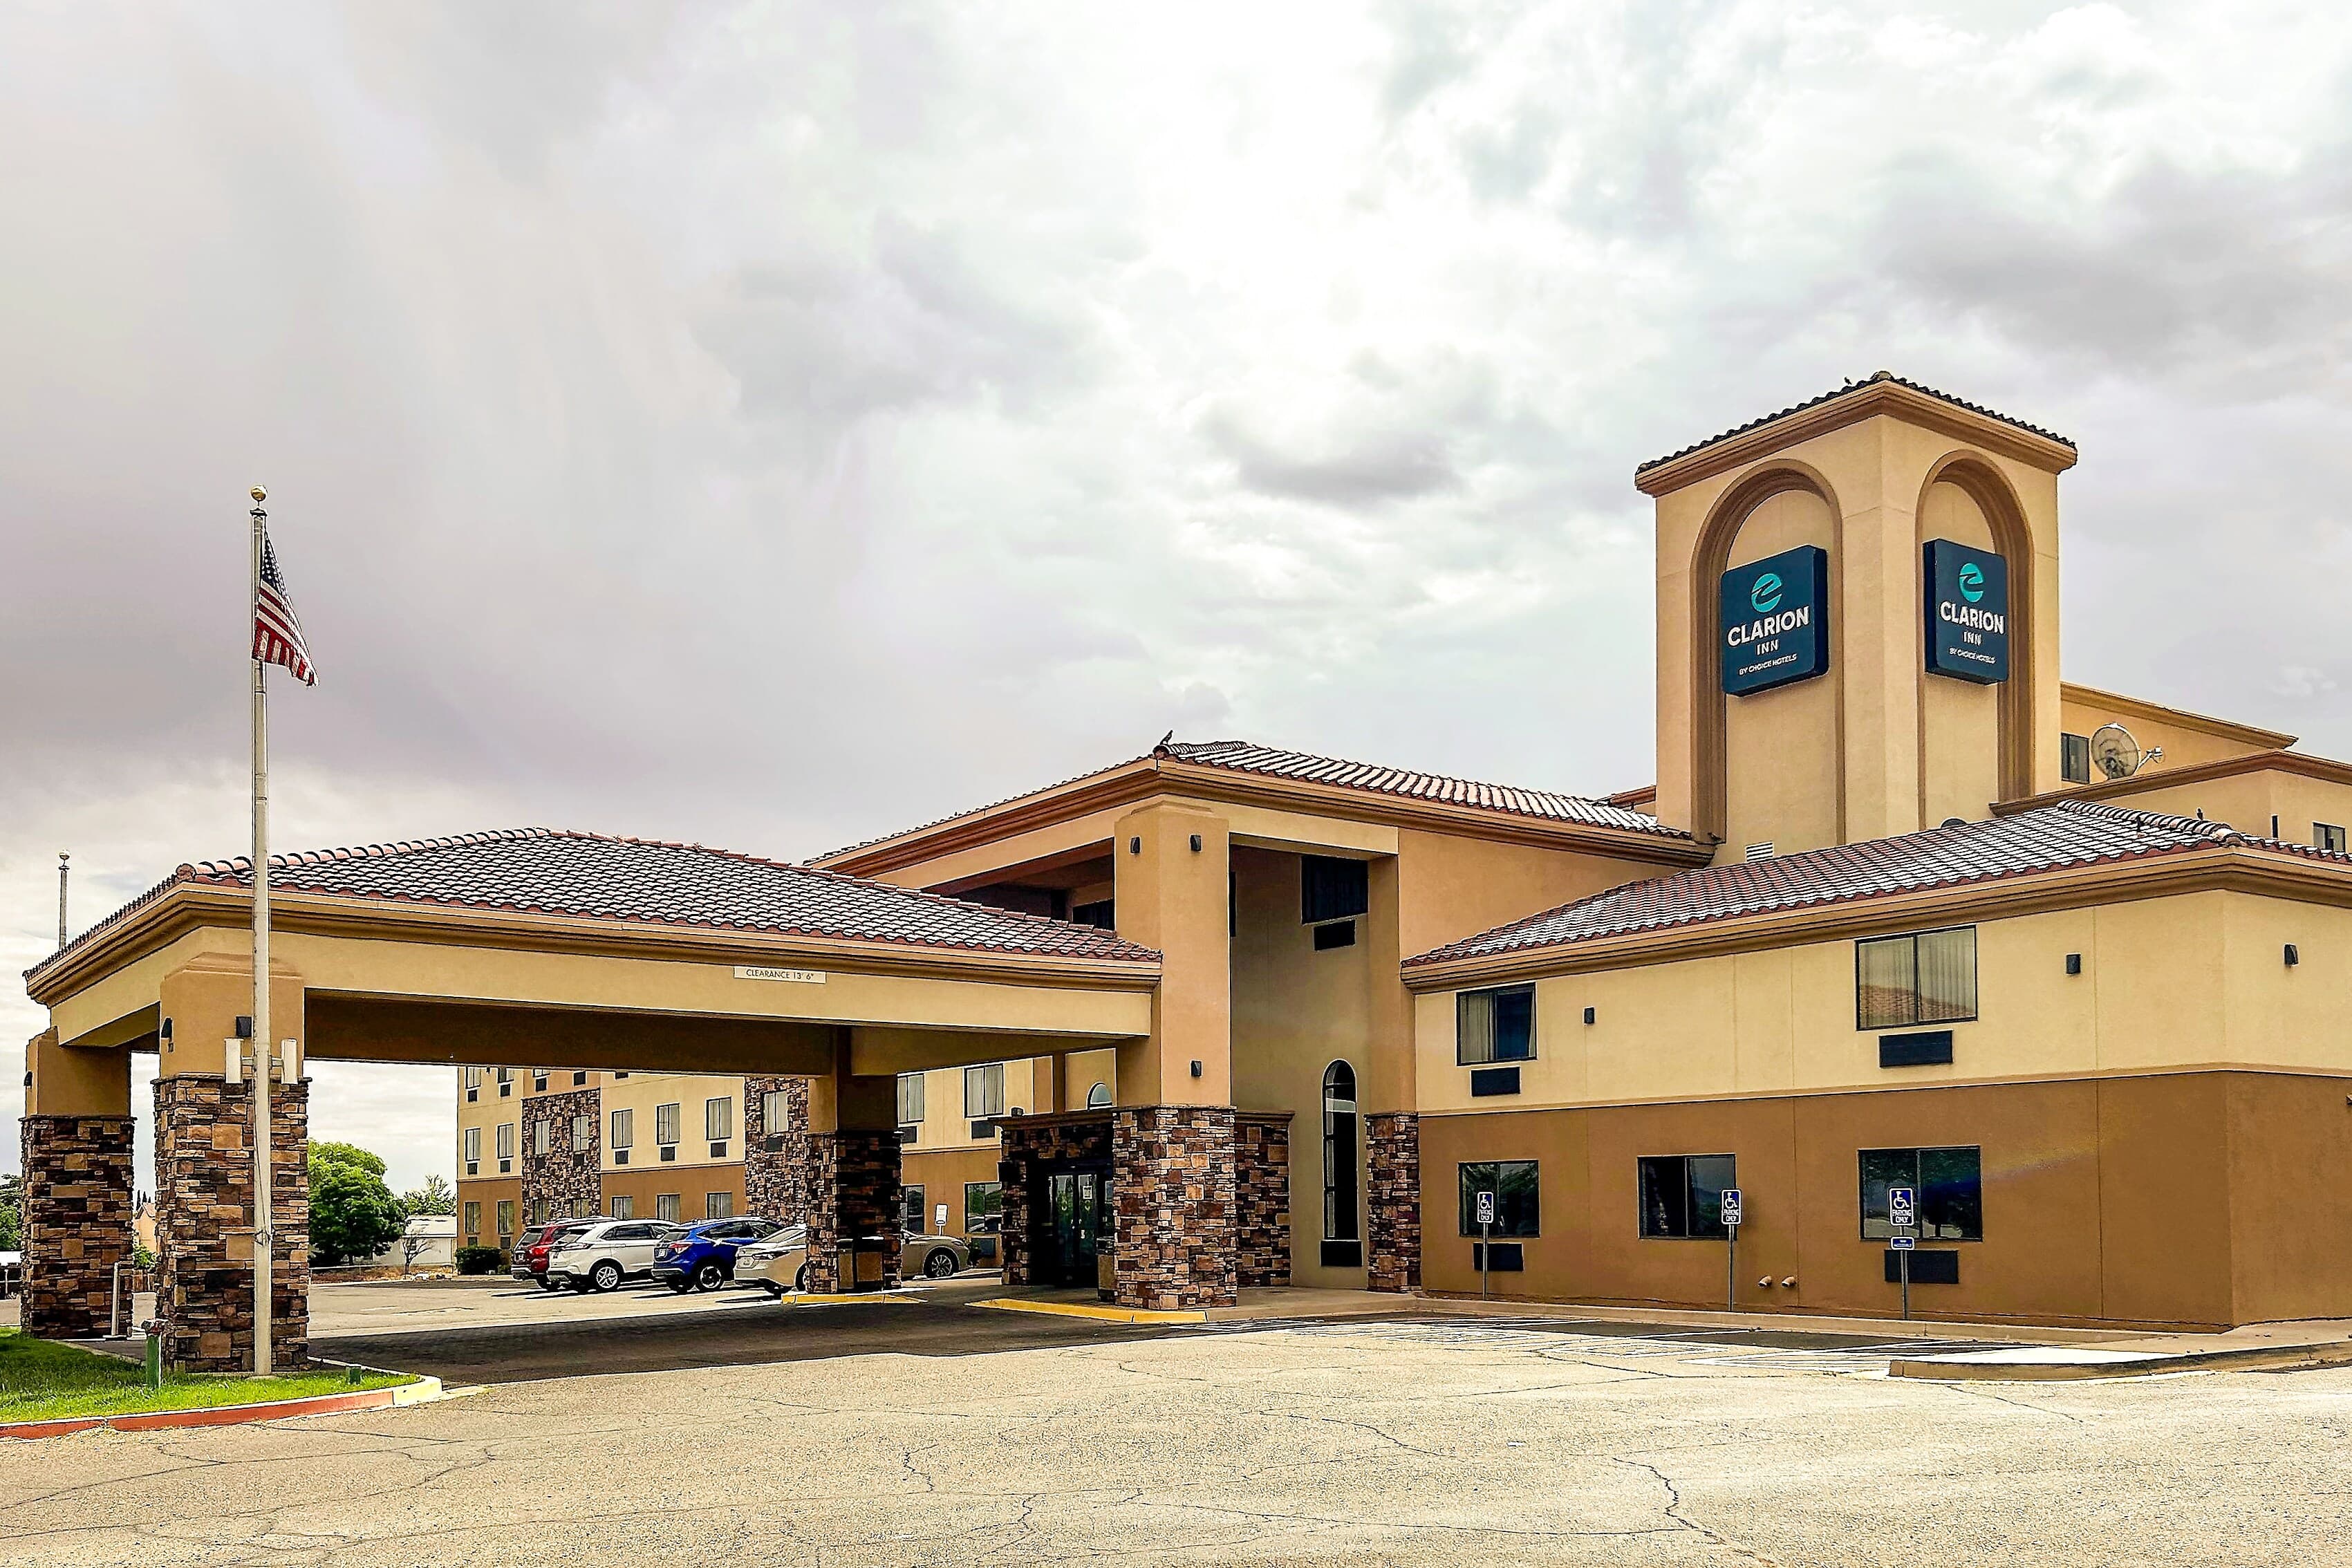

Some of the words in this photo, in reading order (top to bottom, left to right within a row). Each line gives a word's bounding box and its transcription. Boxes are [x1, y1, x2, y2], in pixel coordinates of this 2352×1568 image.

[1728, 606, 1809, 646] CLARION
[1940, 601, 2005, 634] CLARION
[1963, 631, 1982, 646] INN
[1757, 640, 1779, 655] INN
[1748, 660, 1772, 673] CHOICE
[1772, 653, 1798, 666] HOTELS
[746, 969, 790, 979] CLEARANCE
